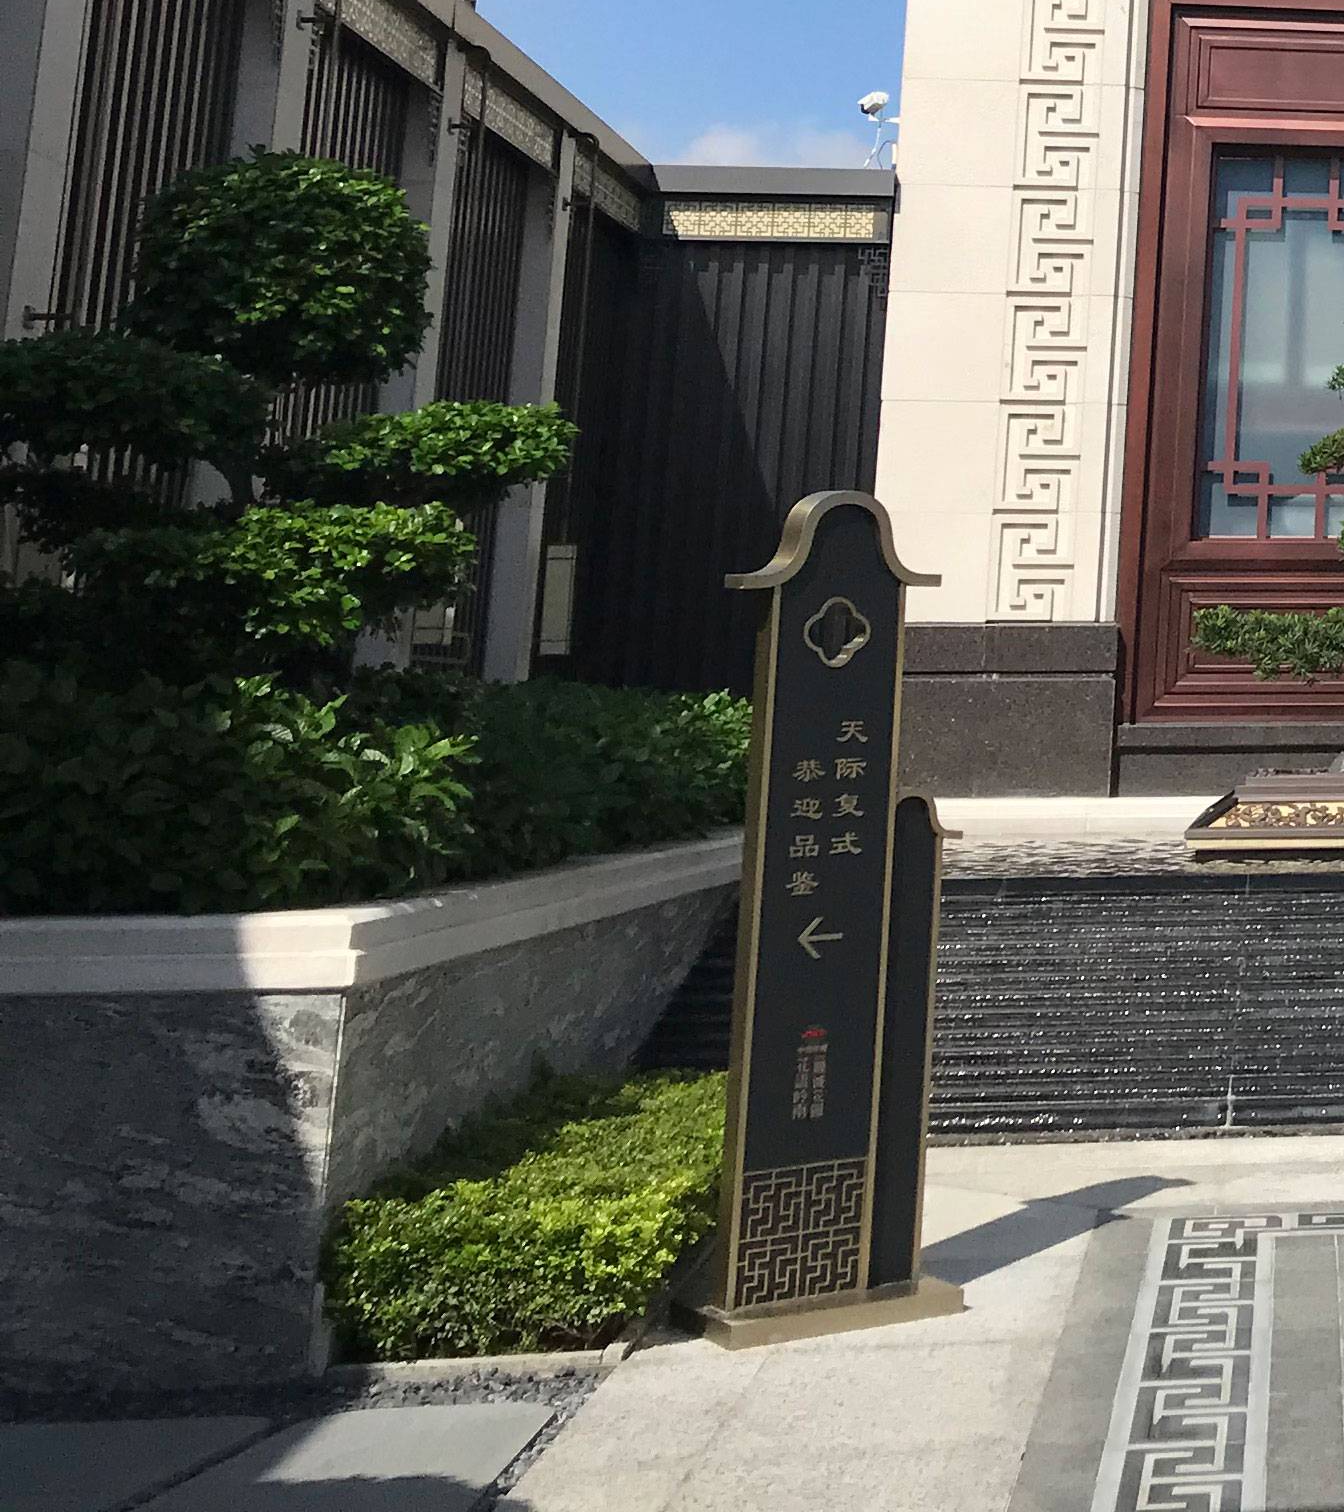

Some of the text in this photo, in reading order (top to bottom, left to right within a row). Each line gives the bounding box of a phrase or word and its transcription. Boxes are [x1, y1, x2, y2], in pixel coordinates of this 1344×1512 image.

[785, 758, 827, 897] 恭迎品鉴
[829, 720, 869, 856] 天际复式
